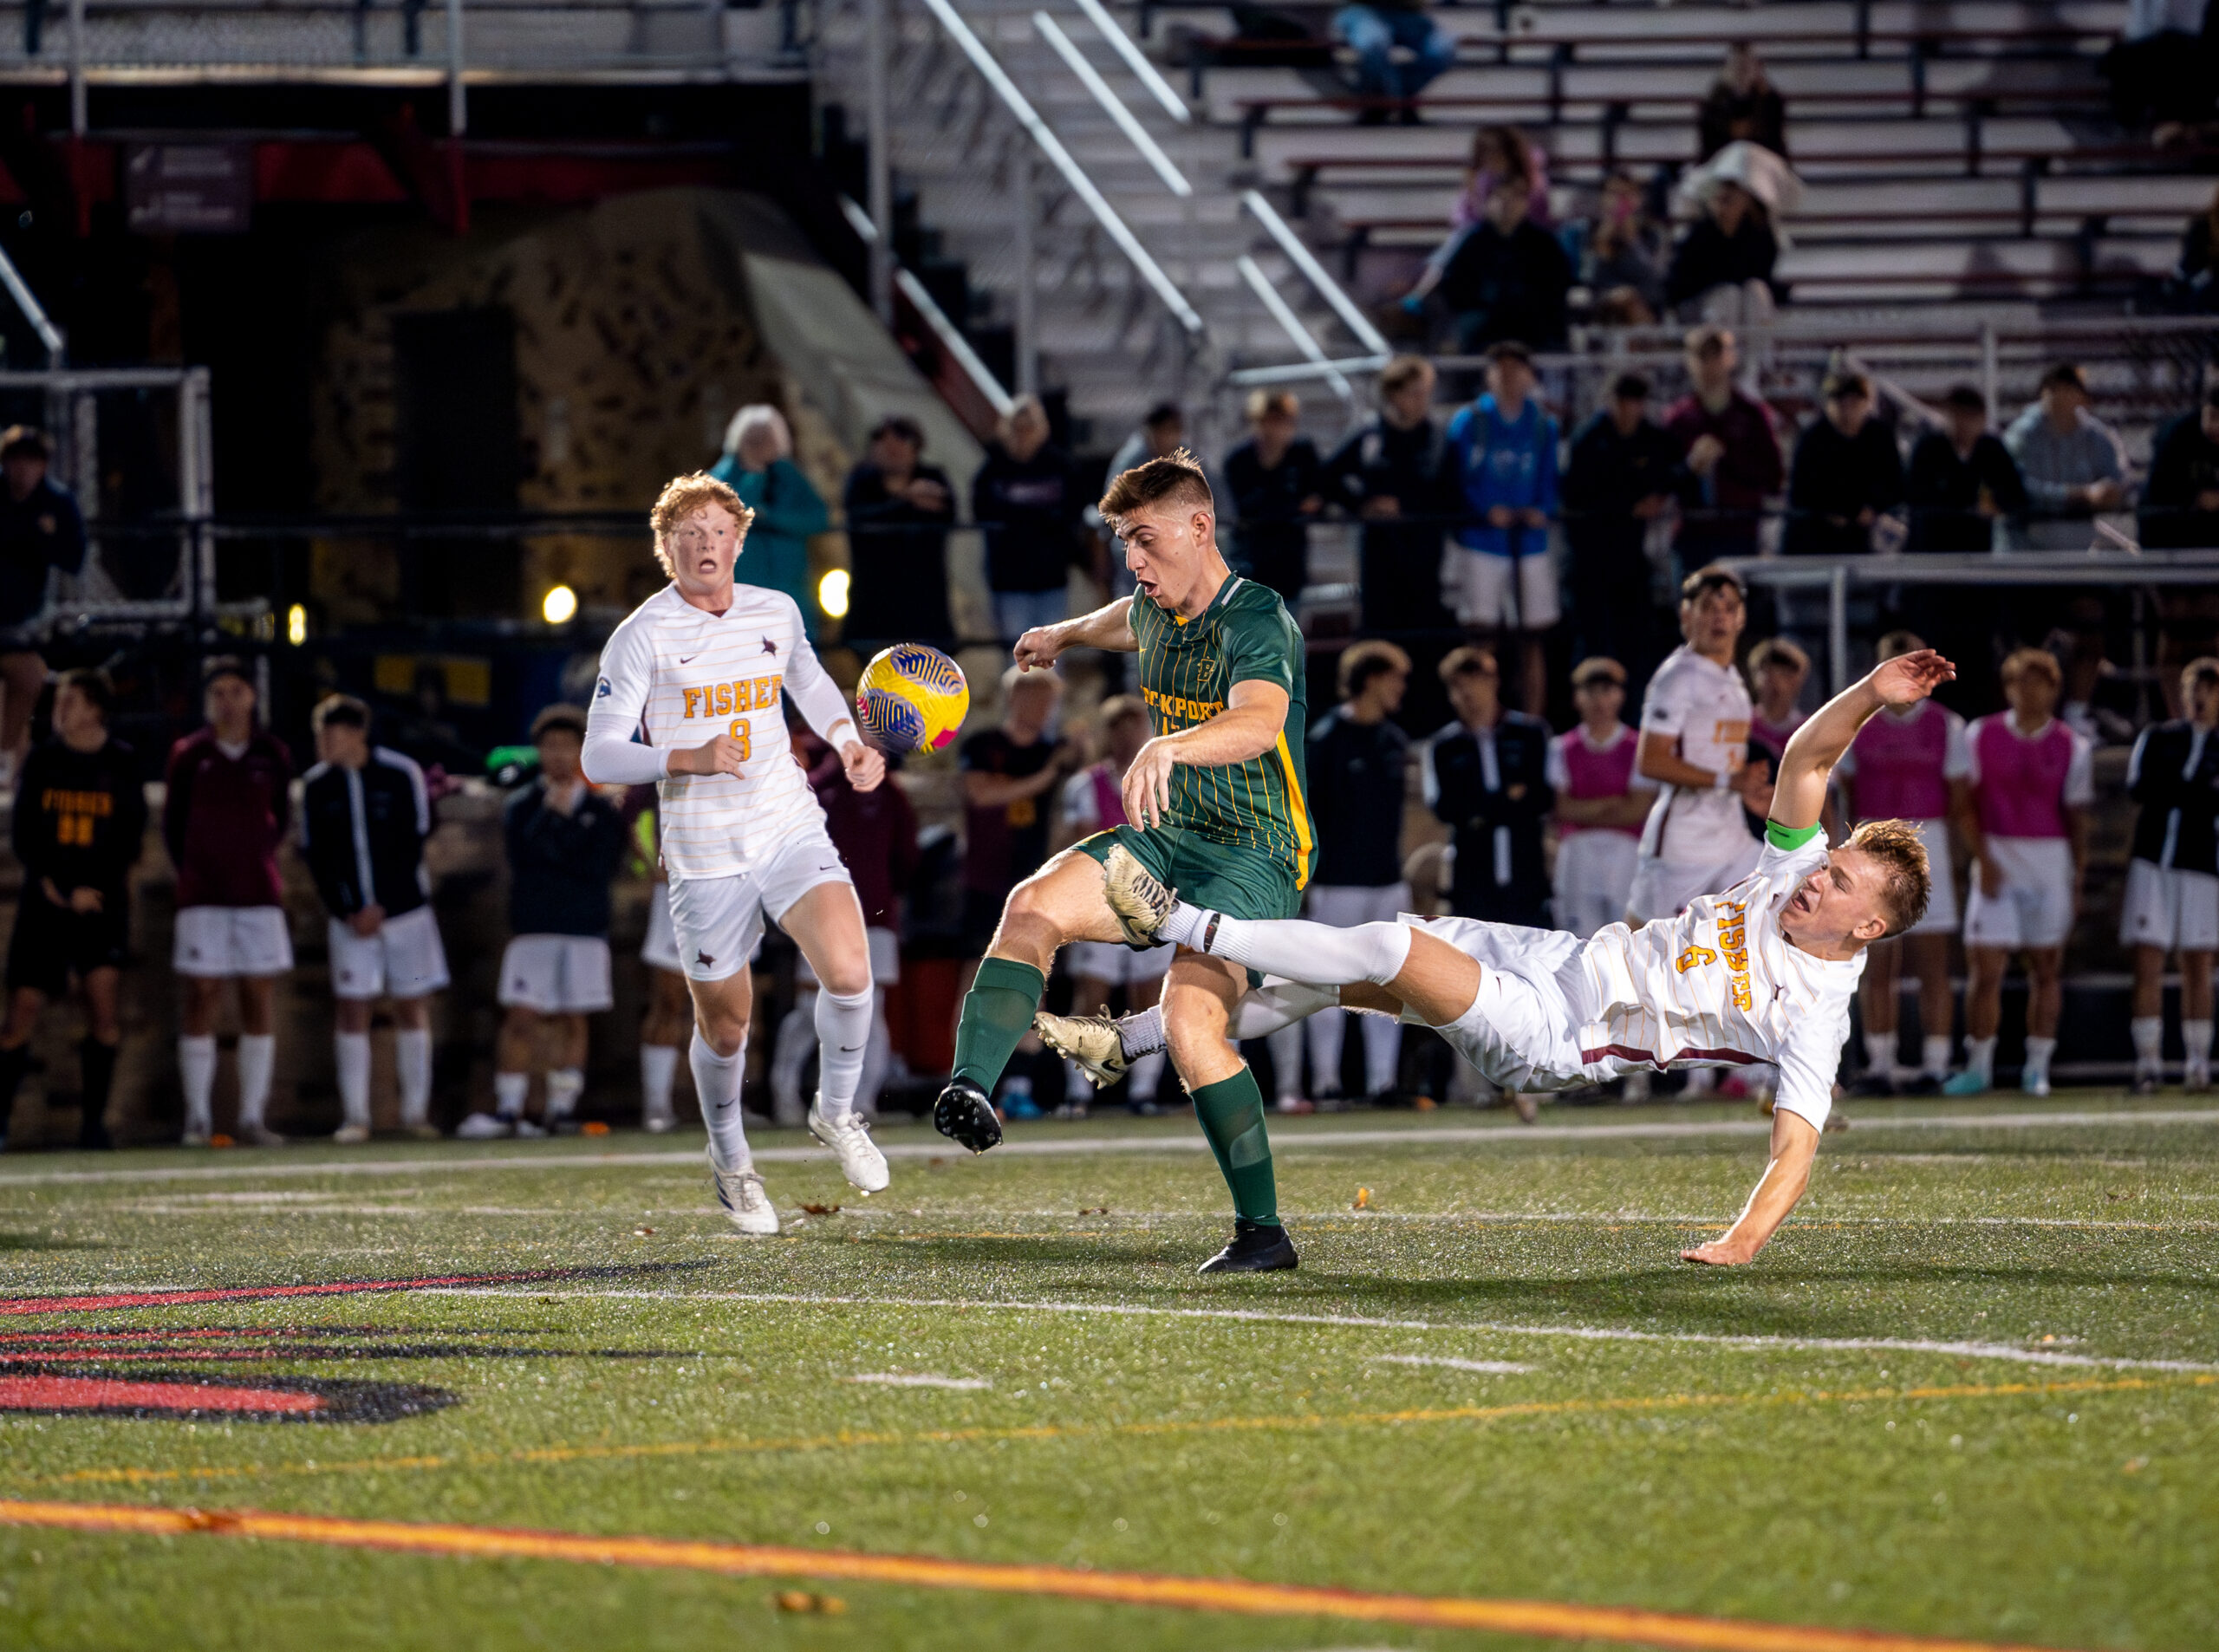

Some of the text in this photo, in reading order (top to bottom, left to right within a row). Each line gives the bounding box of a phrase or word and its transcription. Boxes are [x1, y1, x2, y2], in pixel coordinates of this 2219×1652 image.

[682, 673, 783, 719] FISHER
[729, 718, 752, 762] 8
[1676, 944, 1718, 974] 6
[1714, 901, 1753, 1012] FISHER
